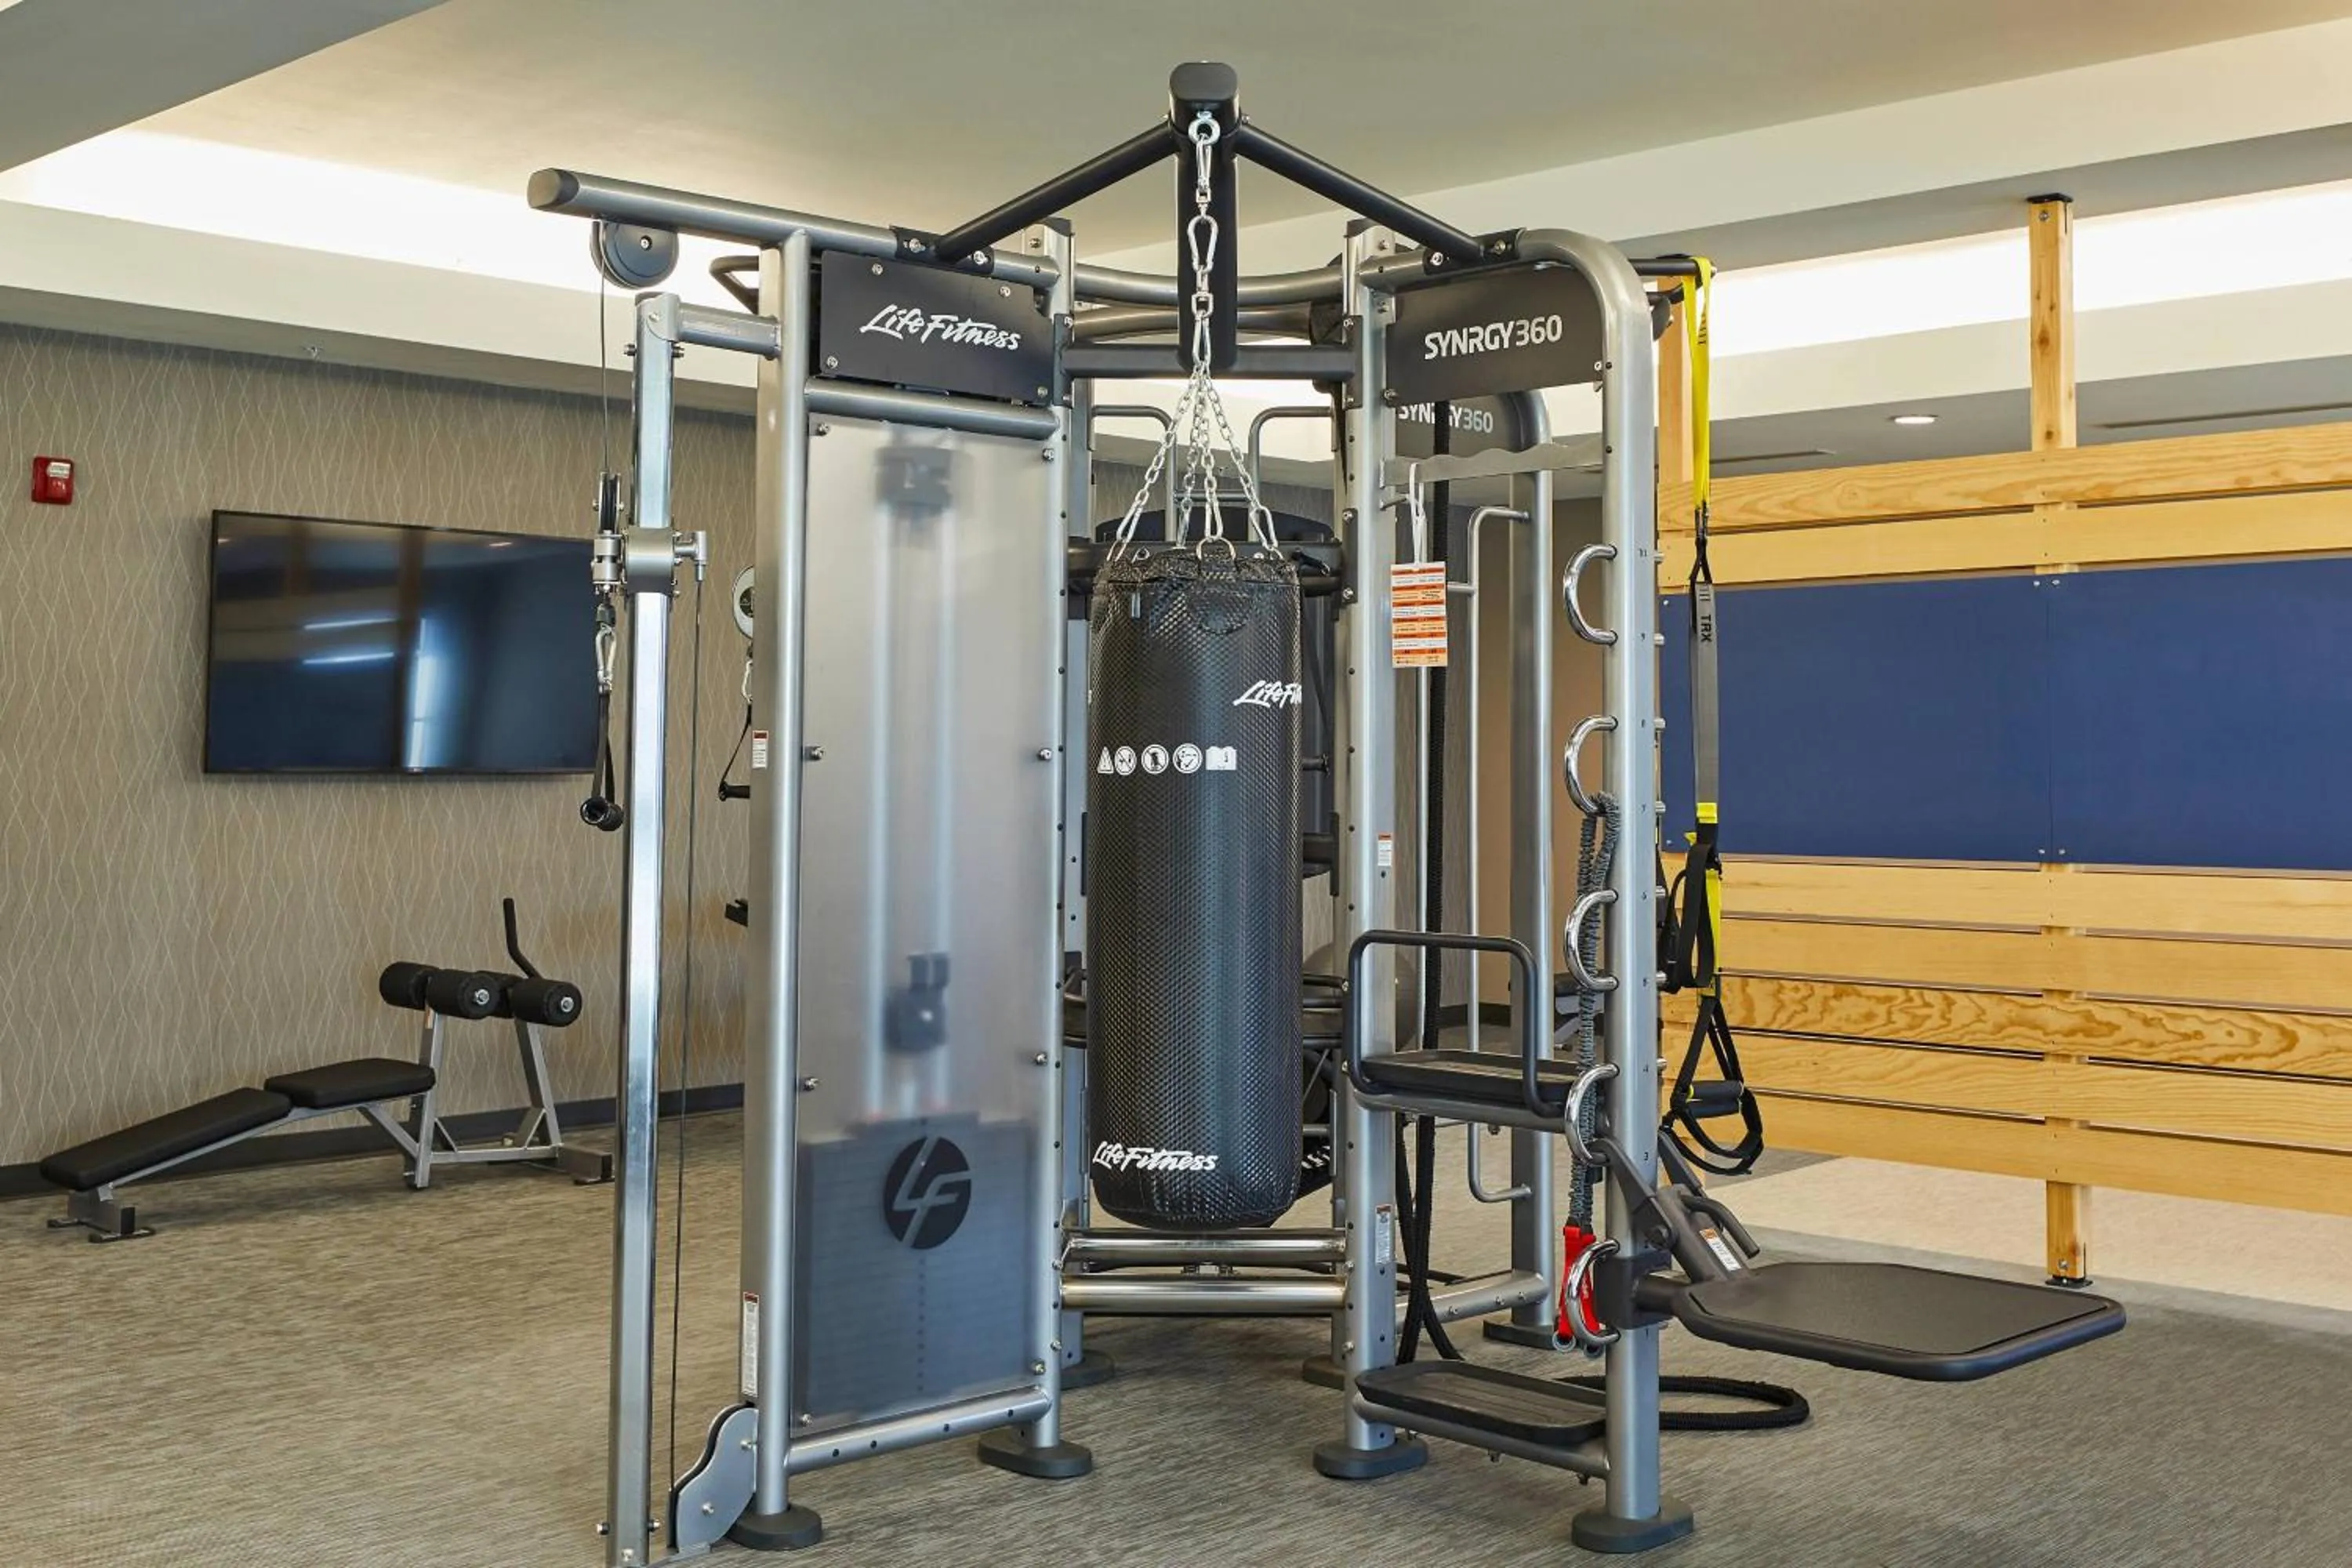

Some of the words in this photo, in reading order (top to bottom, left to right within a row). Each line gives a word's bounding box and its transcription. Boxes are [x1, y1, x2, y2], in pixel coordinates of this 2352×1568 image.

[859, 303, 926, 340] Life
[920, 314, 1022, 350] Fitness
[1424, 314, 1563, 361] SYNRGY360
[1399, 402, 1494, 434] SYNY360
[1700, 614, 1712, 643] TRX
